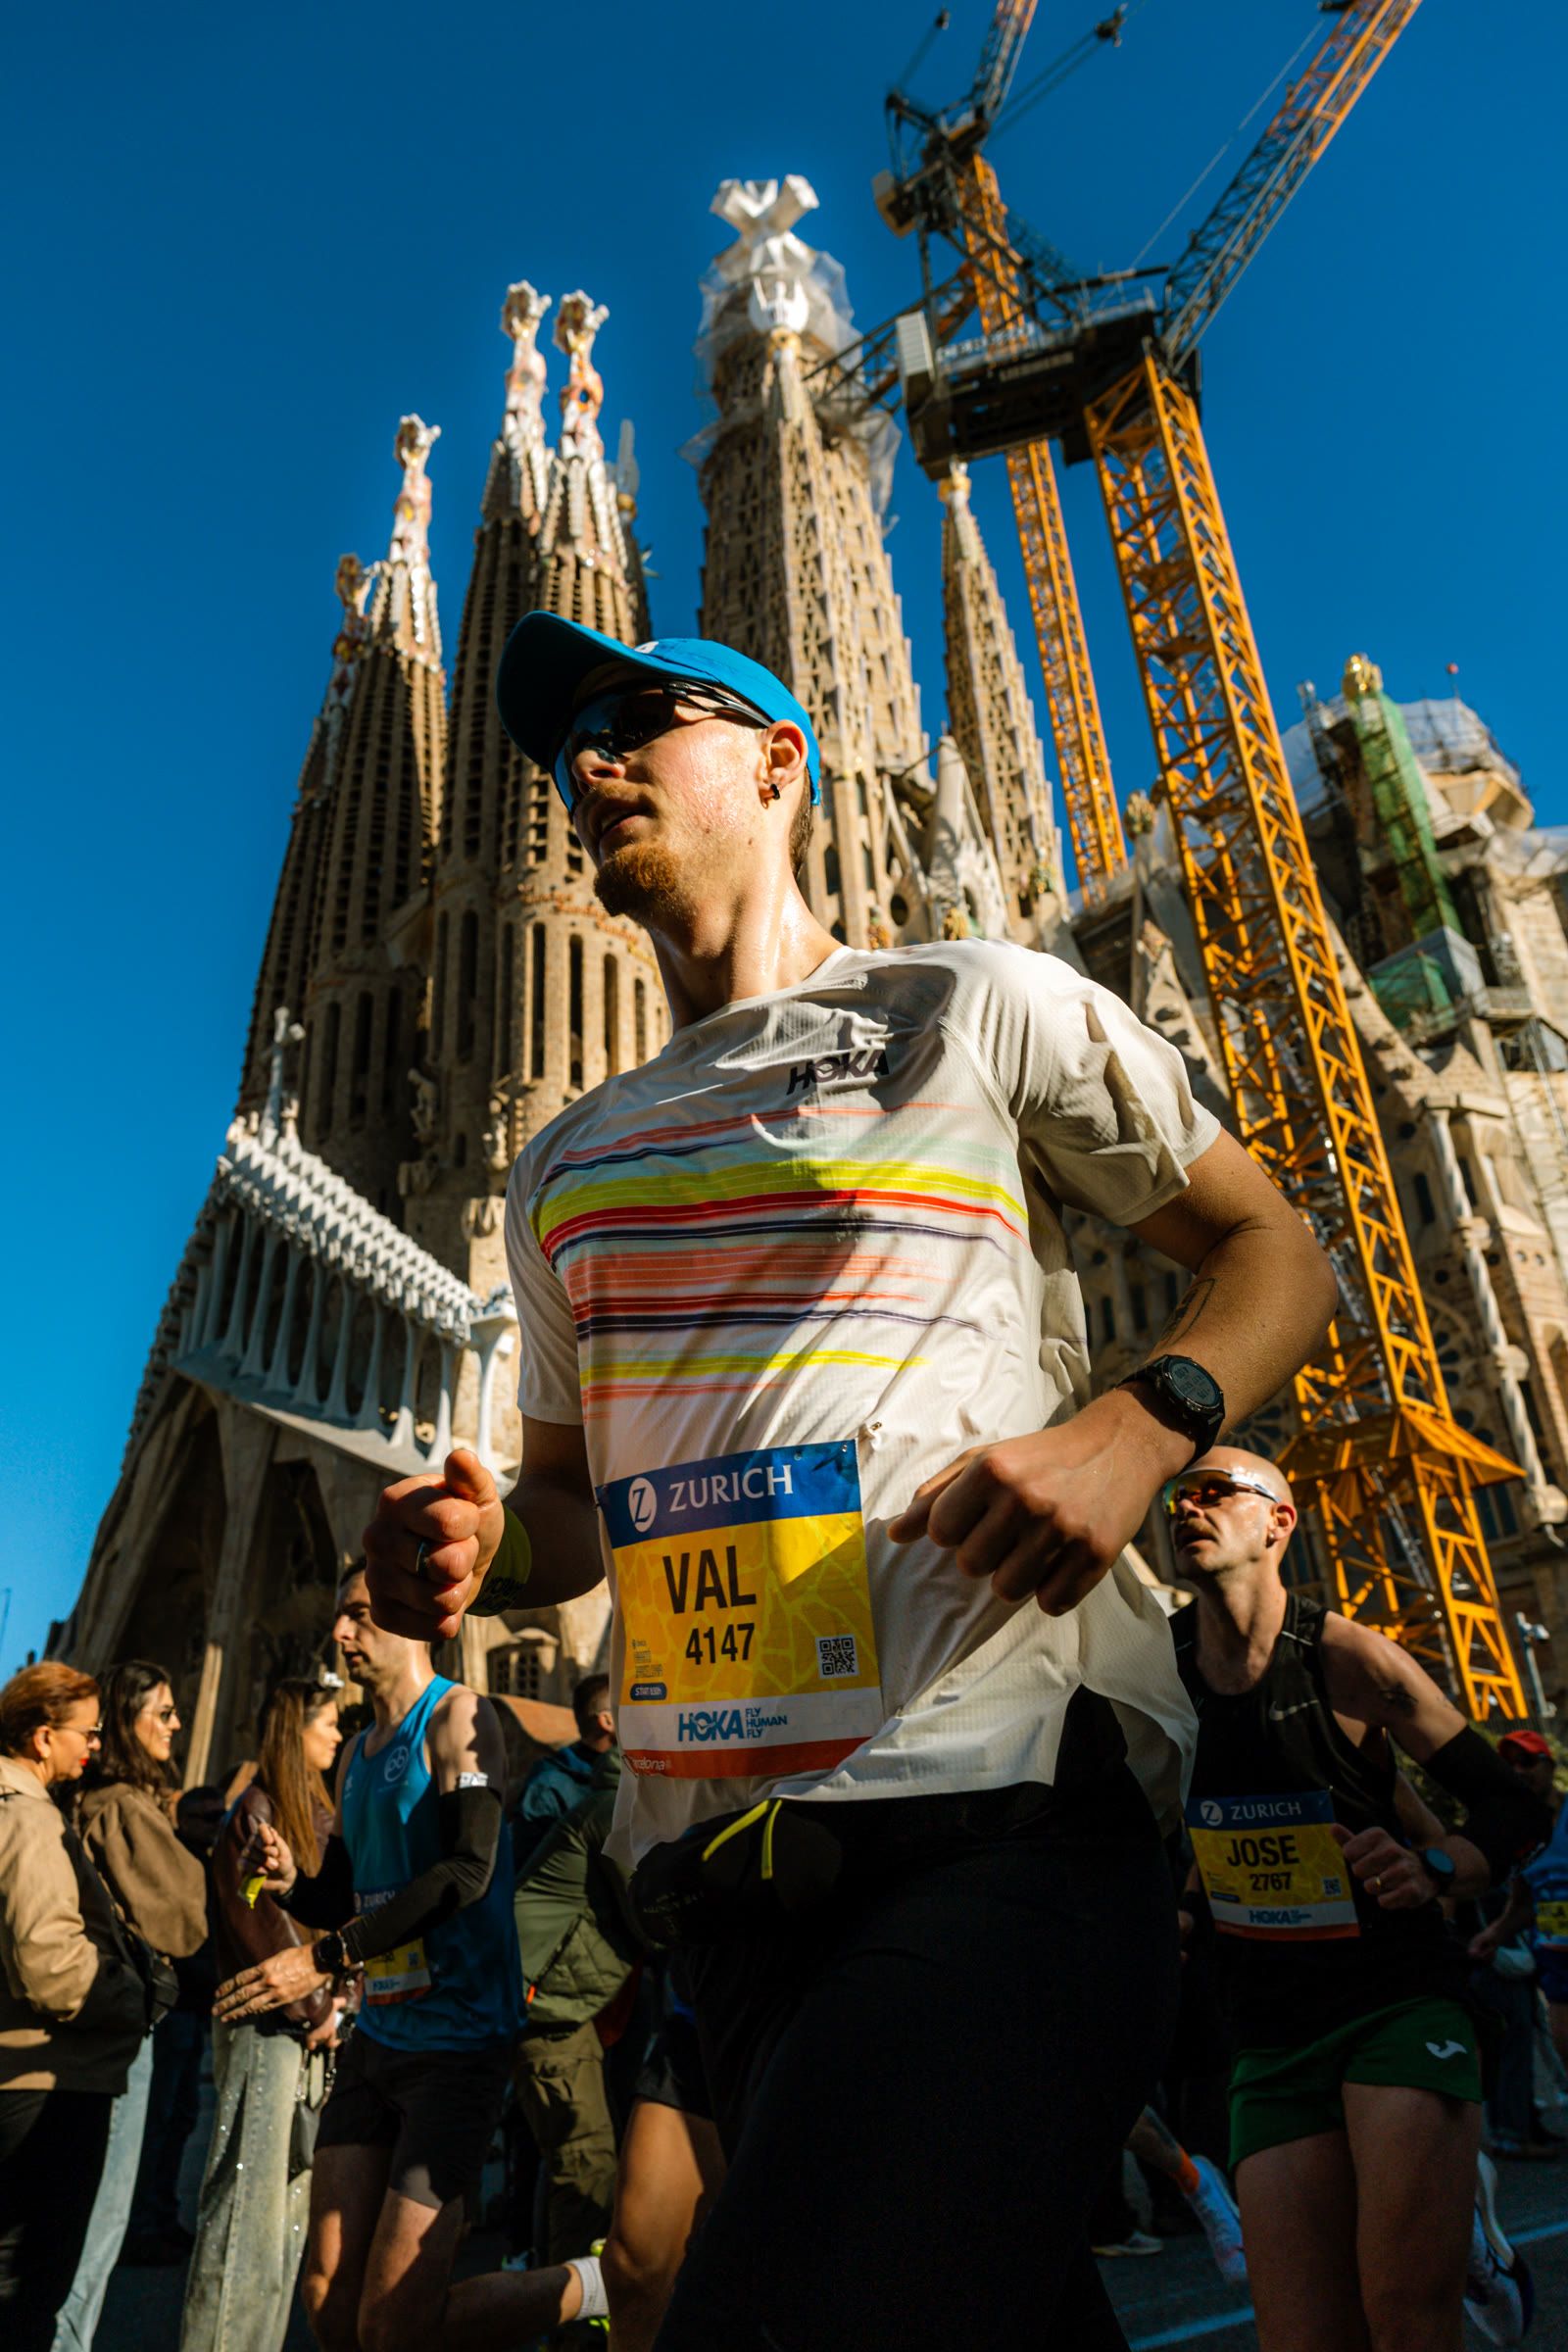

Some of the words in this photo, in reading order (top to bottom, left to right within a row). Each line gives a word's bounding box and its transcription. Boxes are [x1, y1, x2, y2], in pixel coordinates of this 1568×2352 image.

[786, 1050, 890, 1096] HOKA
[668, 1464, 794, 1512] ZURICH
[662, 1545, 757, 1615] VAL
[686, 1622, 756, 1665] 4147
[678, 1709, 745, 1741] HOKA
[745, 1715, 788, 1728] HUMAN
[746, 1707, 761, 1718] FLY
[746, 1728, 763, 1739] FLY
[1230, 1801, 1302, 1821] ZURICH
[1227, 1835, 1300, 1867] JOSE
[1250, 1872, 1292, 1891] 2767
